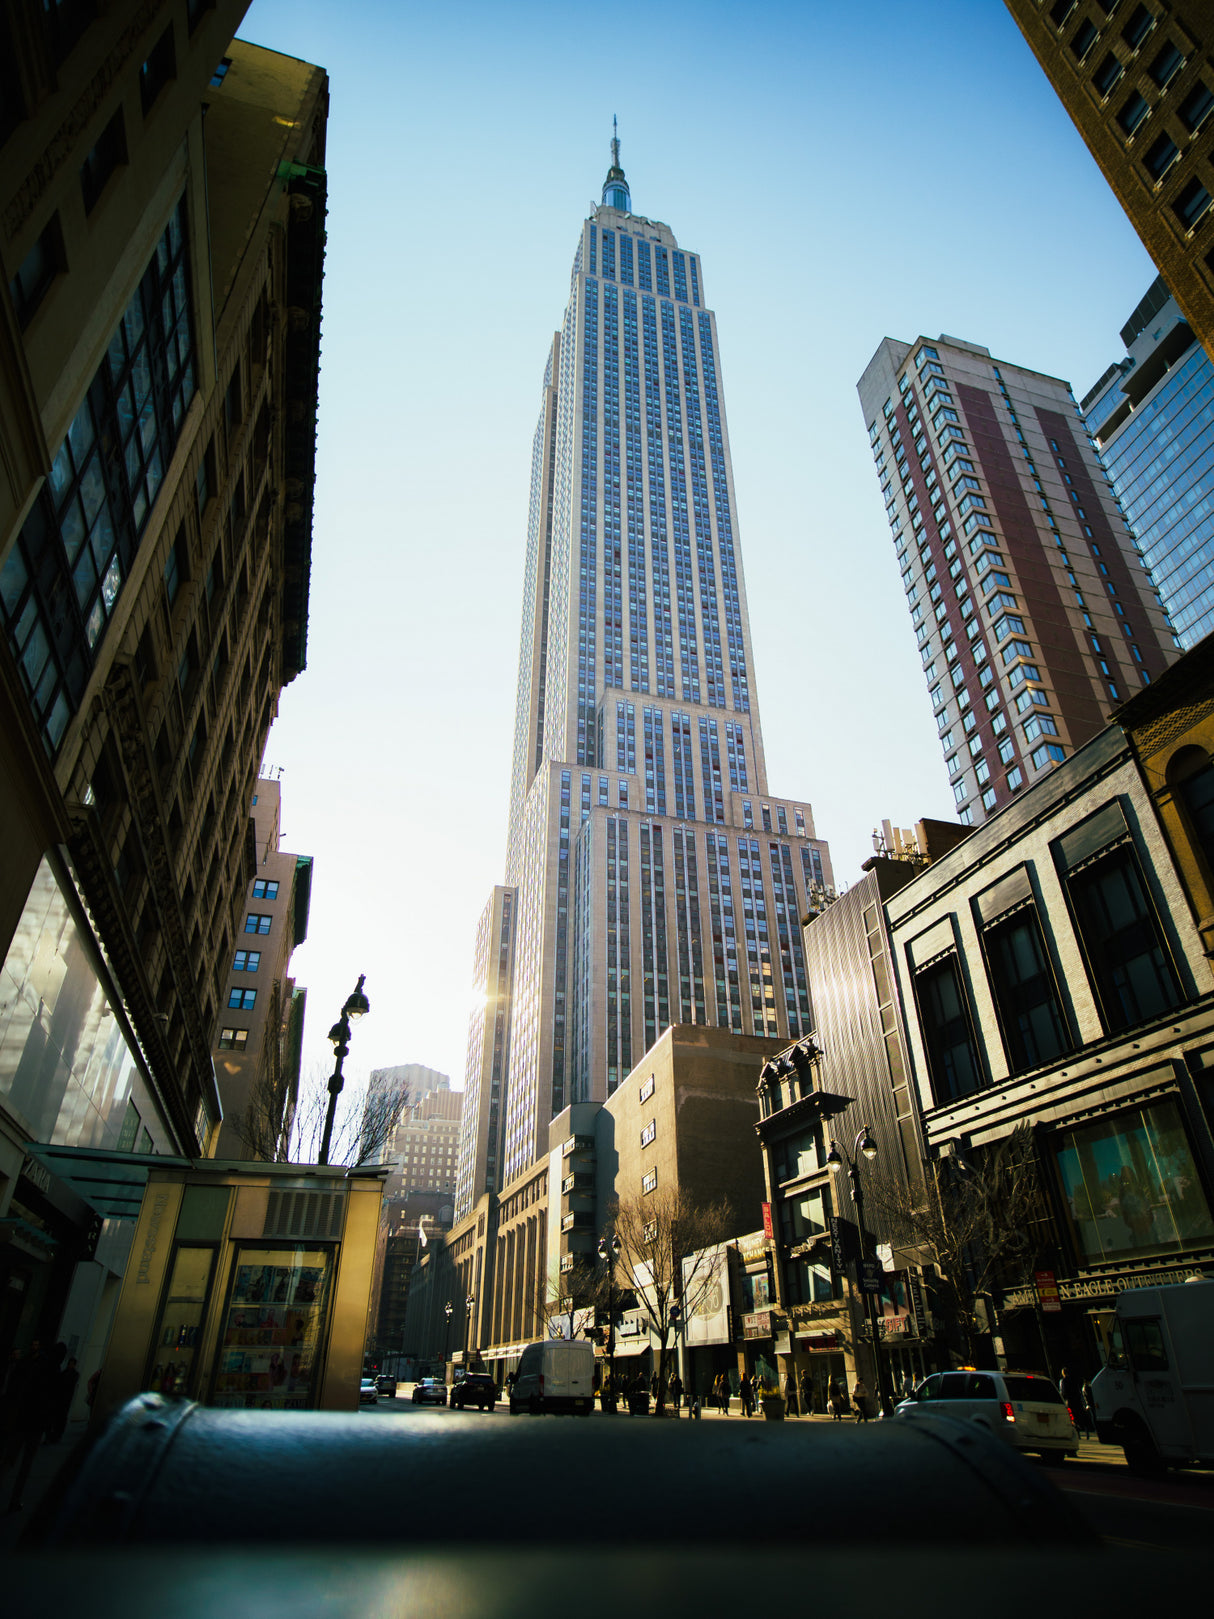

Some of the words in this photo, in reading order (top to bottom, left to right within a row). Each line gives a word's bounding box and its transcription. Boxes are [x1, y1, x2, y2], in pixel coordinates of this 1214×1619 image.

[830, 1217, 839, 1238] NEXT
[833, 1238, 843, 1269] VANITY
[1073, 1279, 1115, 1298] EAGLE
